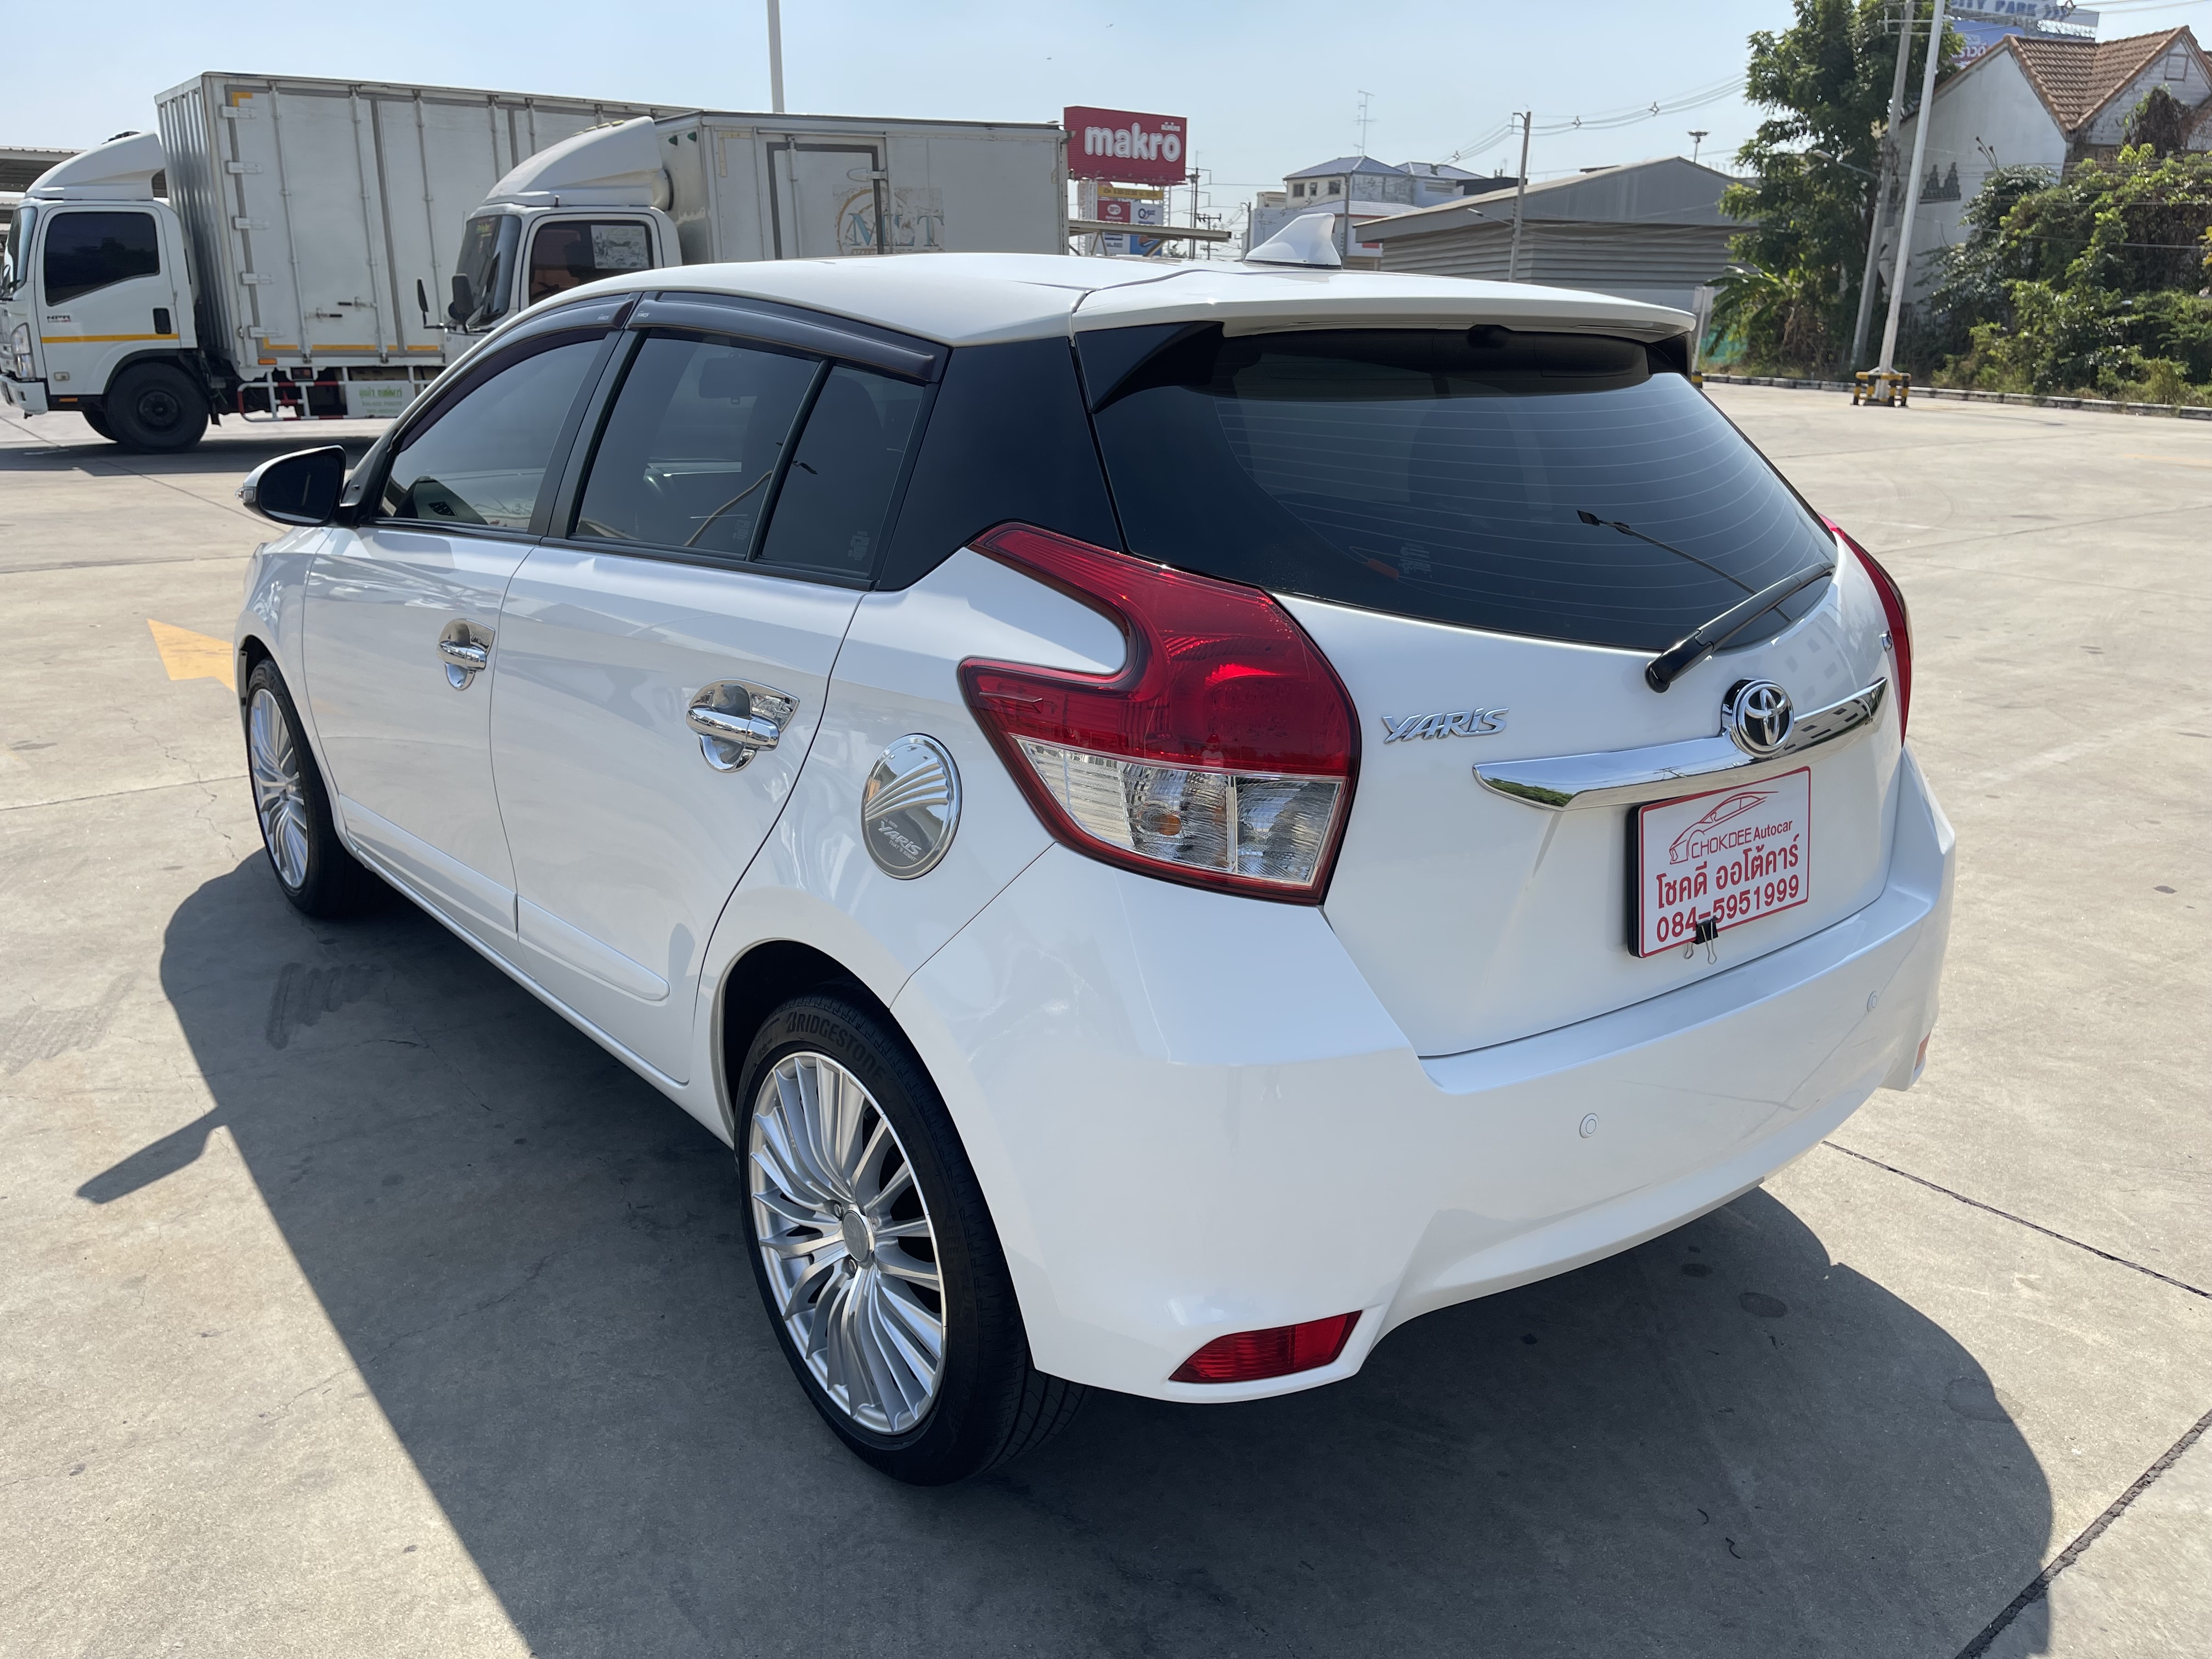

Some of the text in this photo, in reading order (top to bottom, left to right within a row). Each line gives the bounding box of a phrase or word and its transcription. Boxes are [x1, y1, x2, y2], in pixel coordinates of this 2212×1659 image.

[1085, 122, 1182, 162] makro
[1381, 708, 1509, 744] YARIS
[1691, 820, 1793, 859] CHOKDEE Autocar
[1656, 861, 1707, 909] โชคดี
[1656, 874, 1799, 943] 084-5951999
[786, 1011, 886, 1085] BRIDGESTONE
